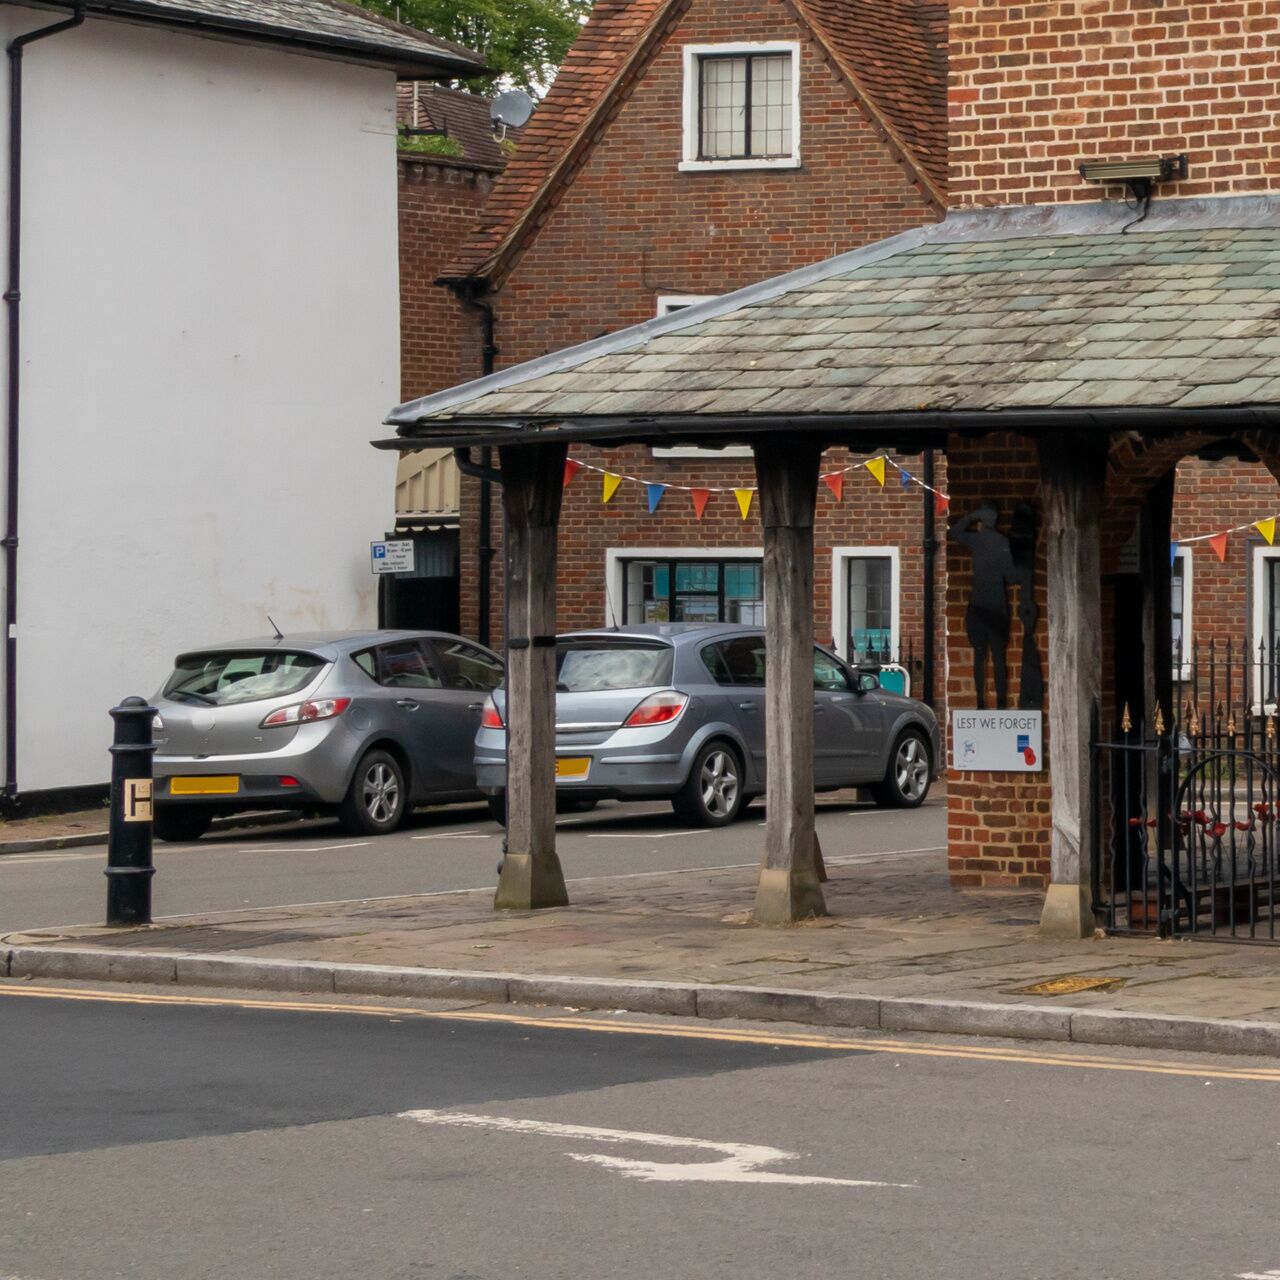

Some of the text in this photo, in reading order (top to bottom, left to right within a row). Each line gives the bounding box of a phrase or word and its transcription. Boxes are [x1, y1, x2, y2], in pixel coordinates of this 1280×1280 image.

[957, 717, 1037, 729] LEST WE FORGET
[130, 783, 153, 817] H
